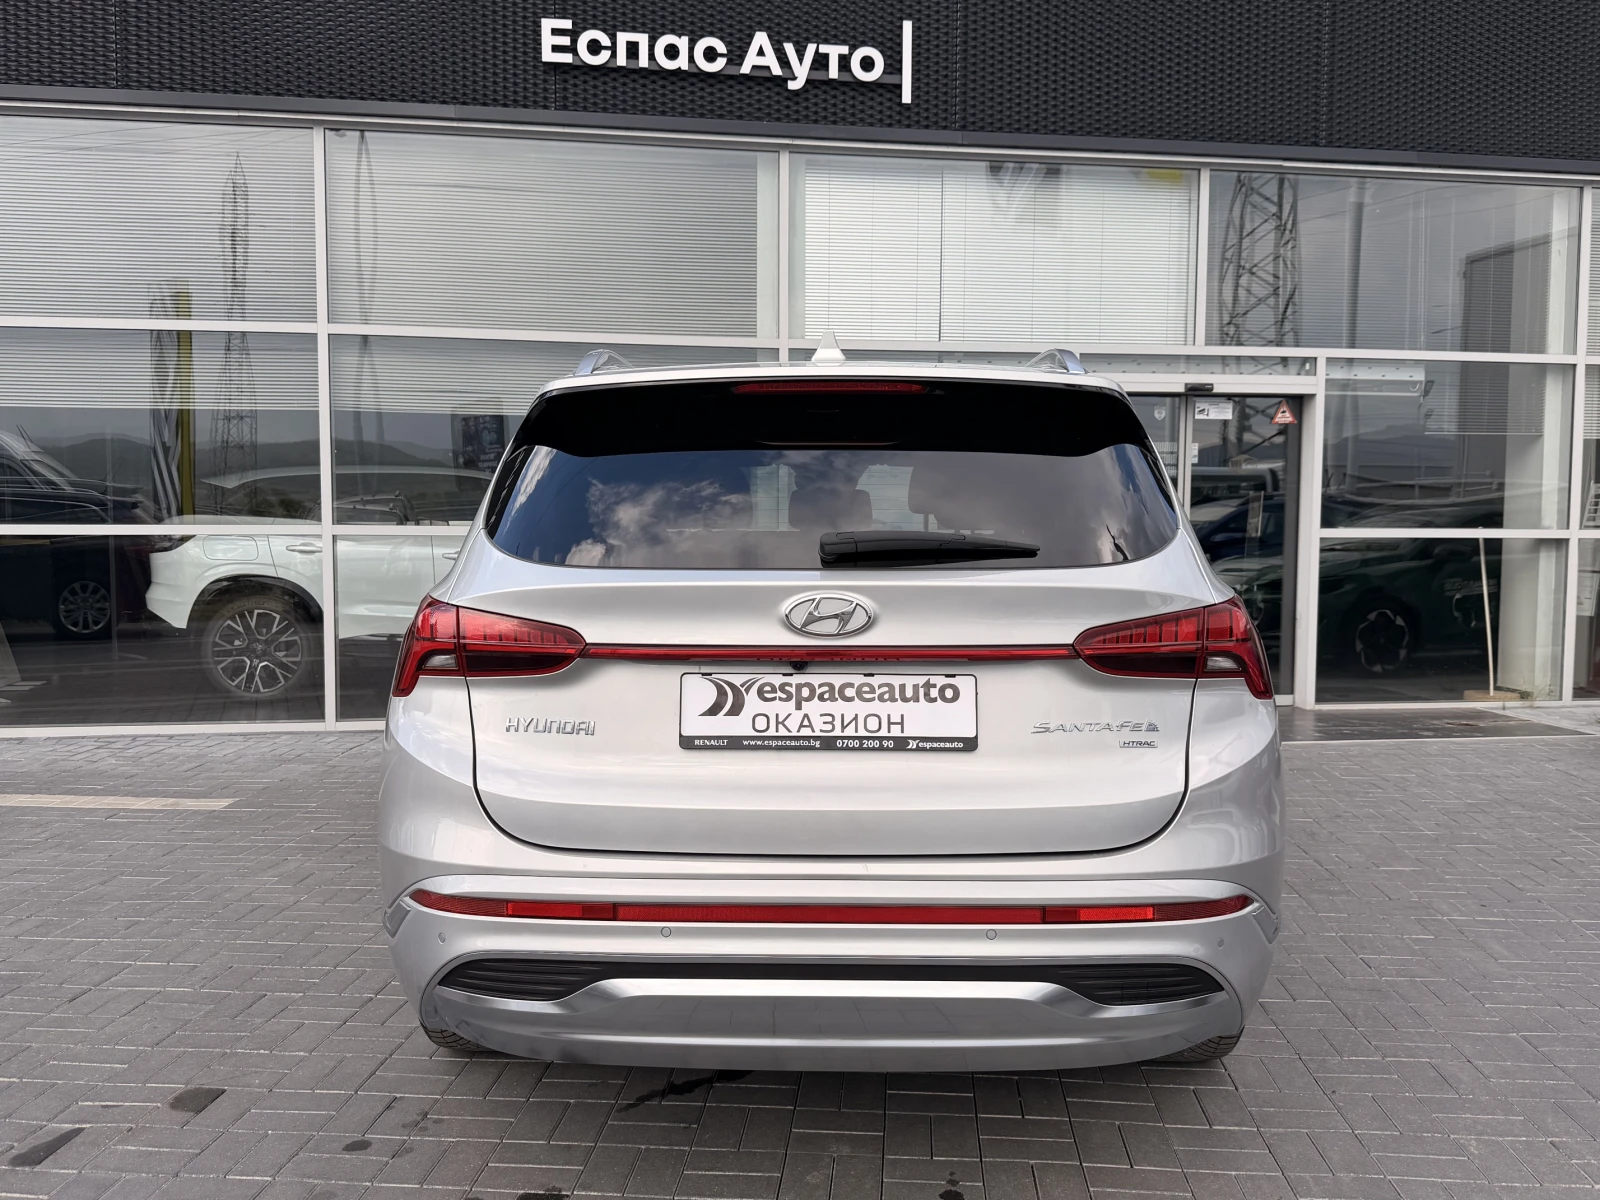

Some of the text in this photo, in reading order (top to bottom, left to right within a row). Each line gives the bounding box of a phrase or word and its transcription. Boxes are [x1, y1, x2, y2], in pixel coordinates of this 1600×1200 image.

[541, 18, 885, 90] Еспас Ауто
[756, 677, 961, 711] espaceauto
[505, 717, 596, 736] HYUNDAI
[751, 712, 905, 734] ОКАЗИОН
[1031, 720, 1114, 734] SANTA
[742, 739, 821, 748] www.espaceauto.bg
[836, 739, 894, 748] 0700 200 90
[918, 741, 964, 749] espaceauto
